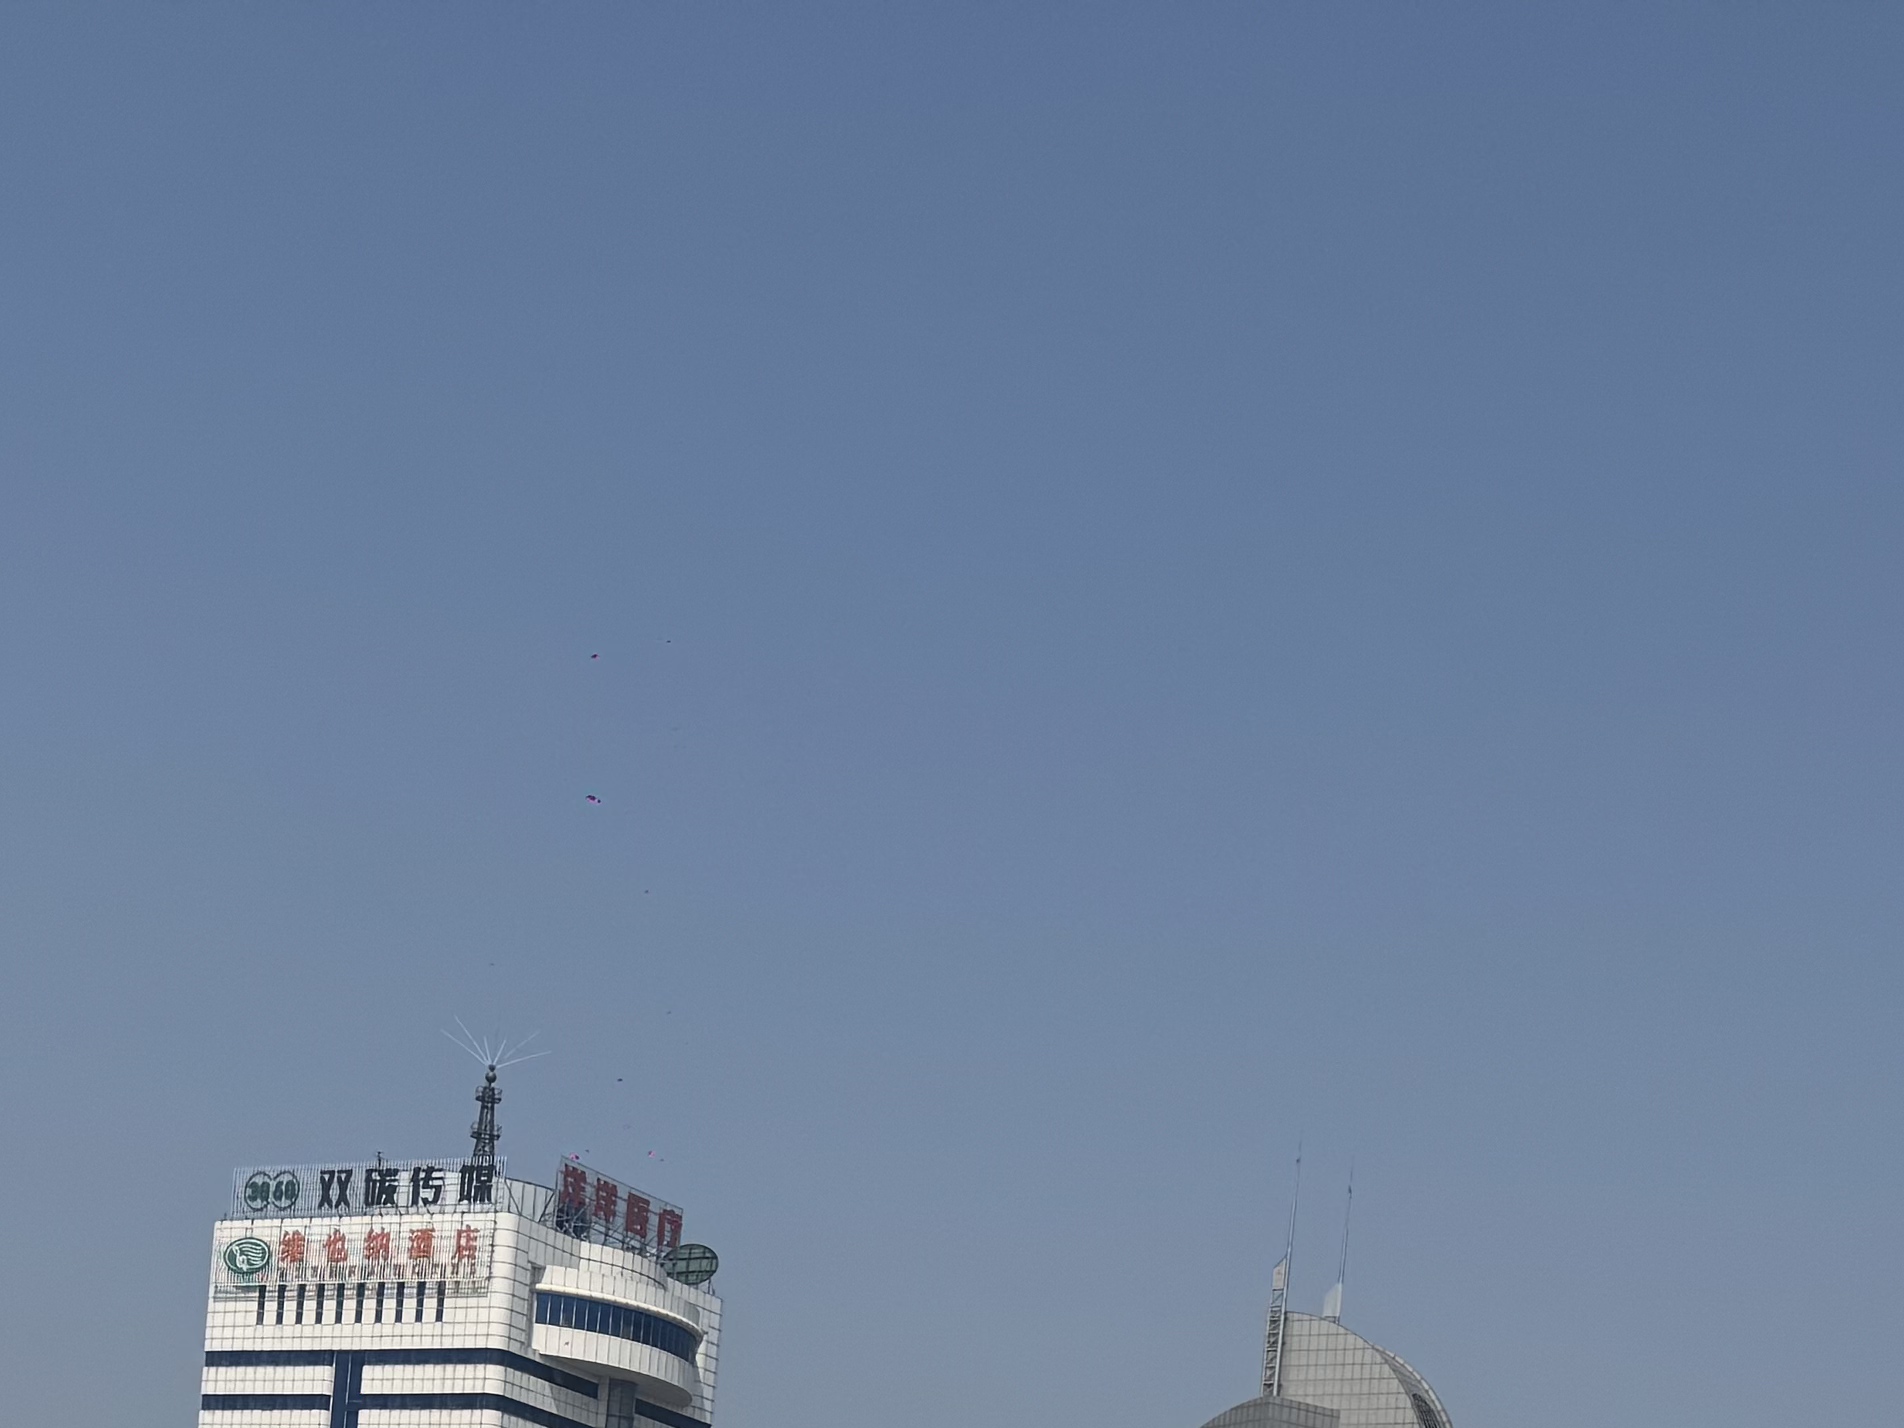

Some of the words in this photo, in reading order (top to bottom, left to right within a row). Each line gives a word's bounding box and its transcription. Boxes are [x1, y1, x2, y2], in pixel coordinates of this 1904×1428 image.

[318, 1164, 496, 1210] 双碳传媒
[277, 1223, 480, 1265] 维也纳酒店
